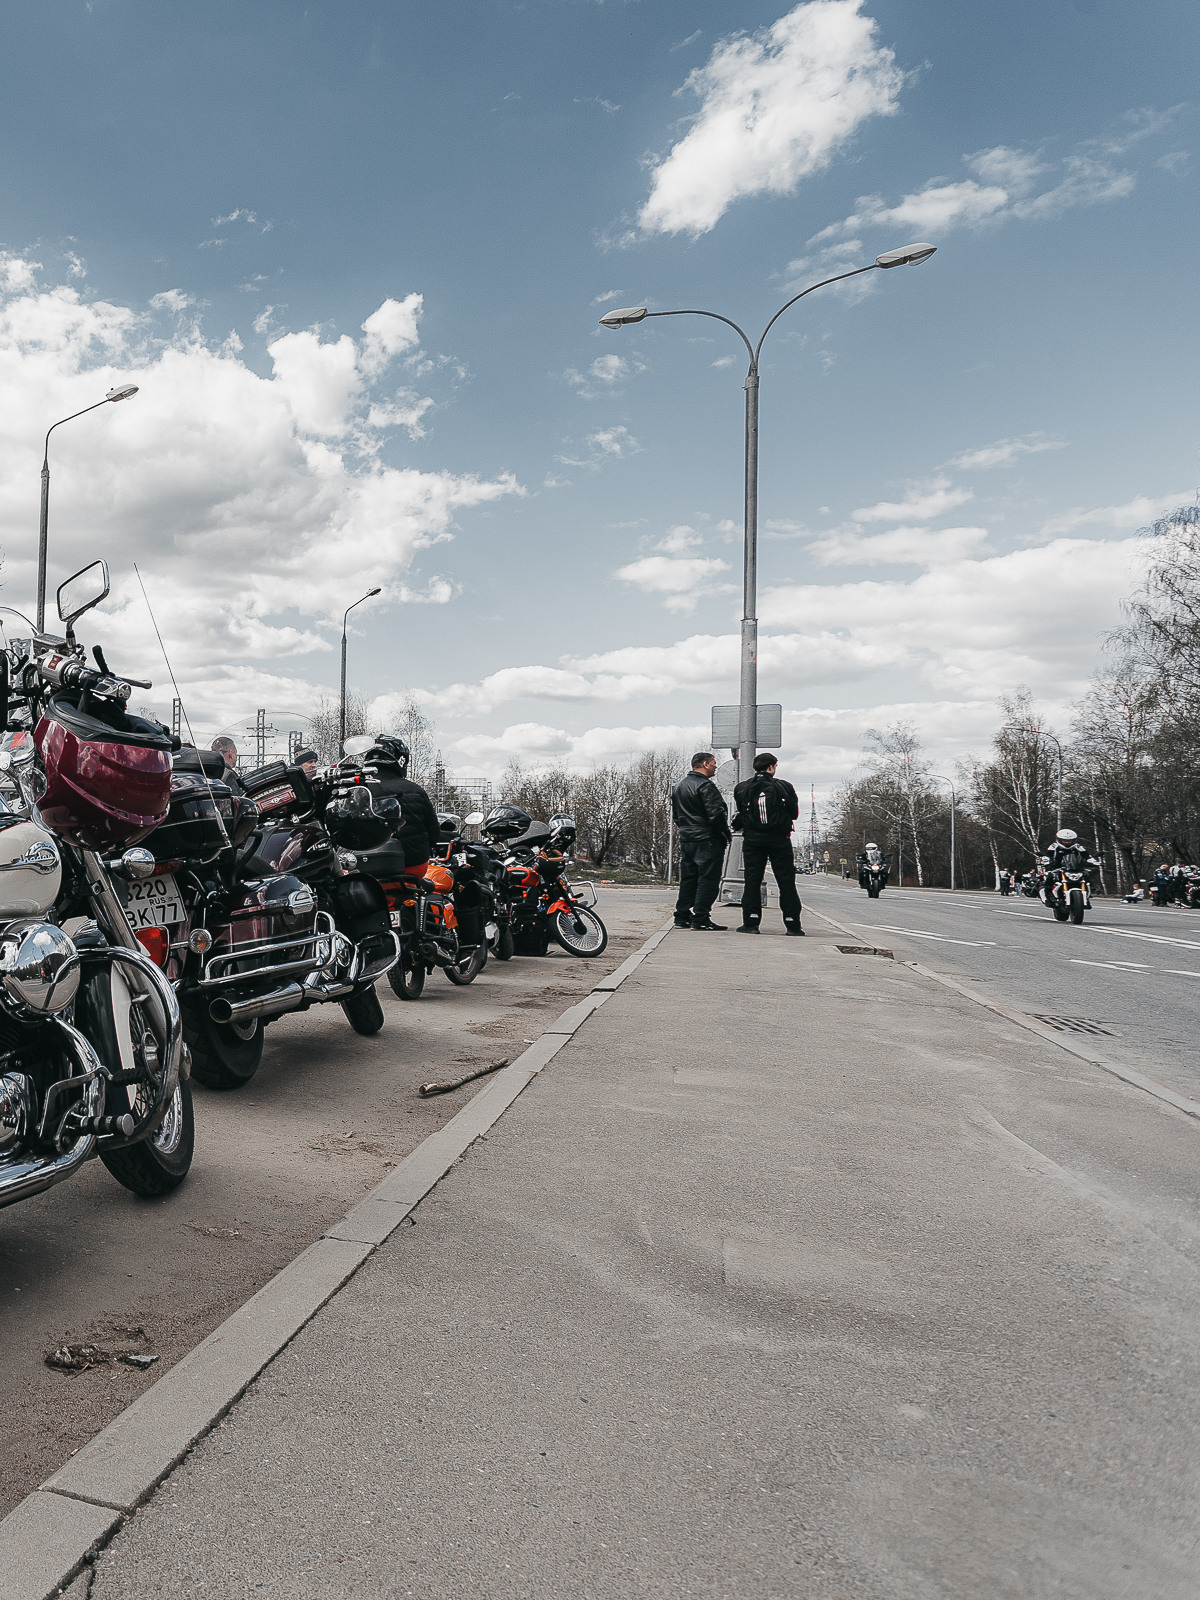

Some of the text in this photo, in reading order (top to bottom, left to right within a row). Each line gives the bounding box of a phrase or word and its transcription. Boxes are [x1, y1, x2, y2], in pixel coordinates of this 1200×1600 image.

[128, 879, 167, 902] 220
[149, 897, 167, 906] RUS
[156, 903, 178, 923] 77
